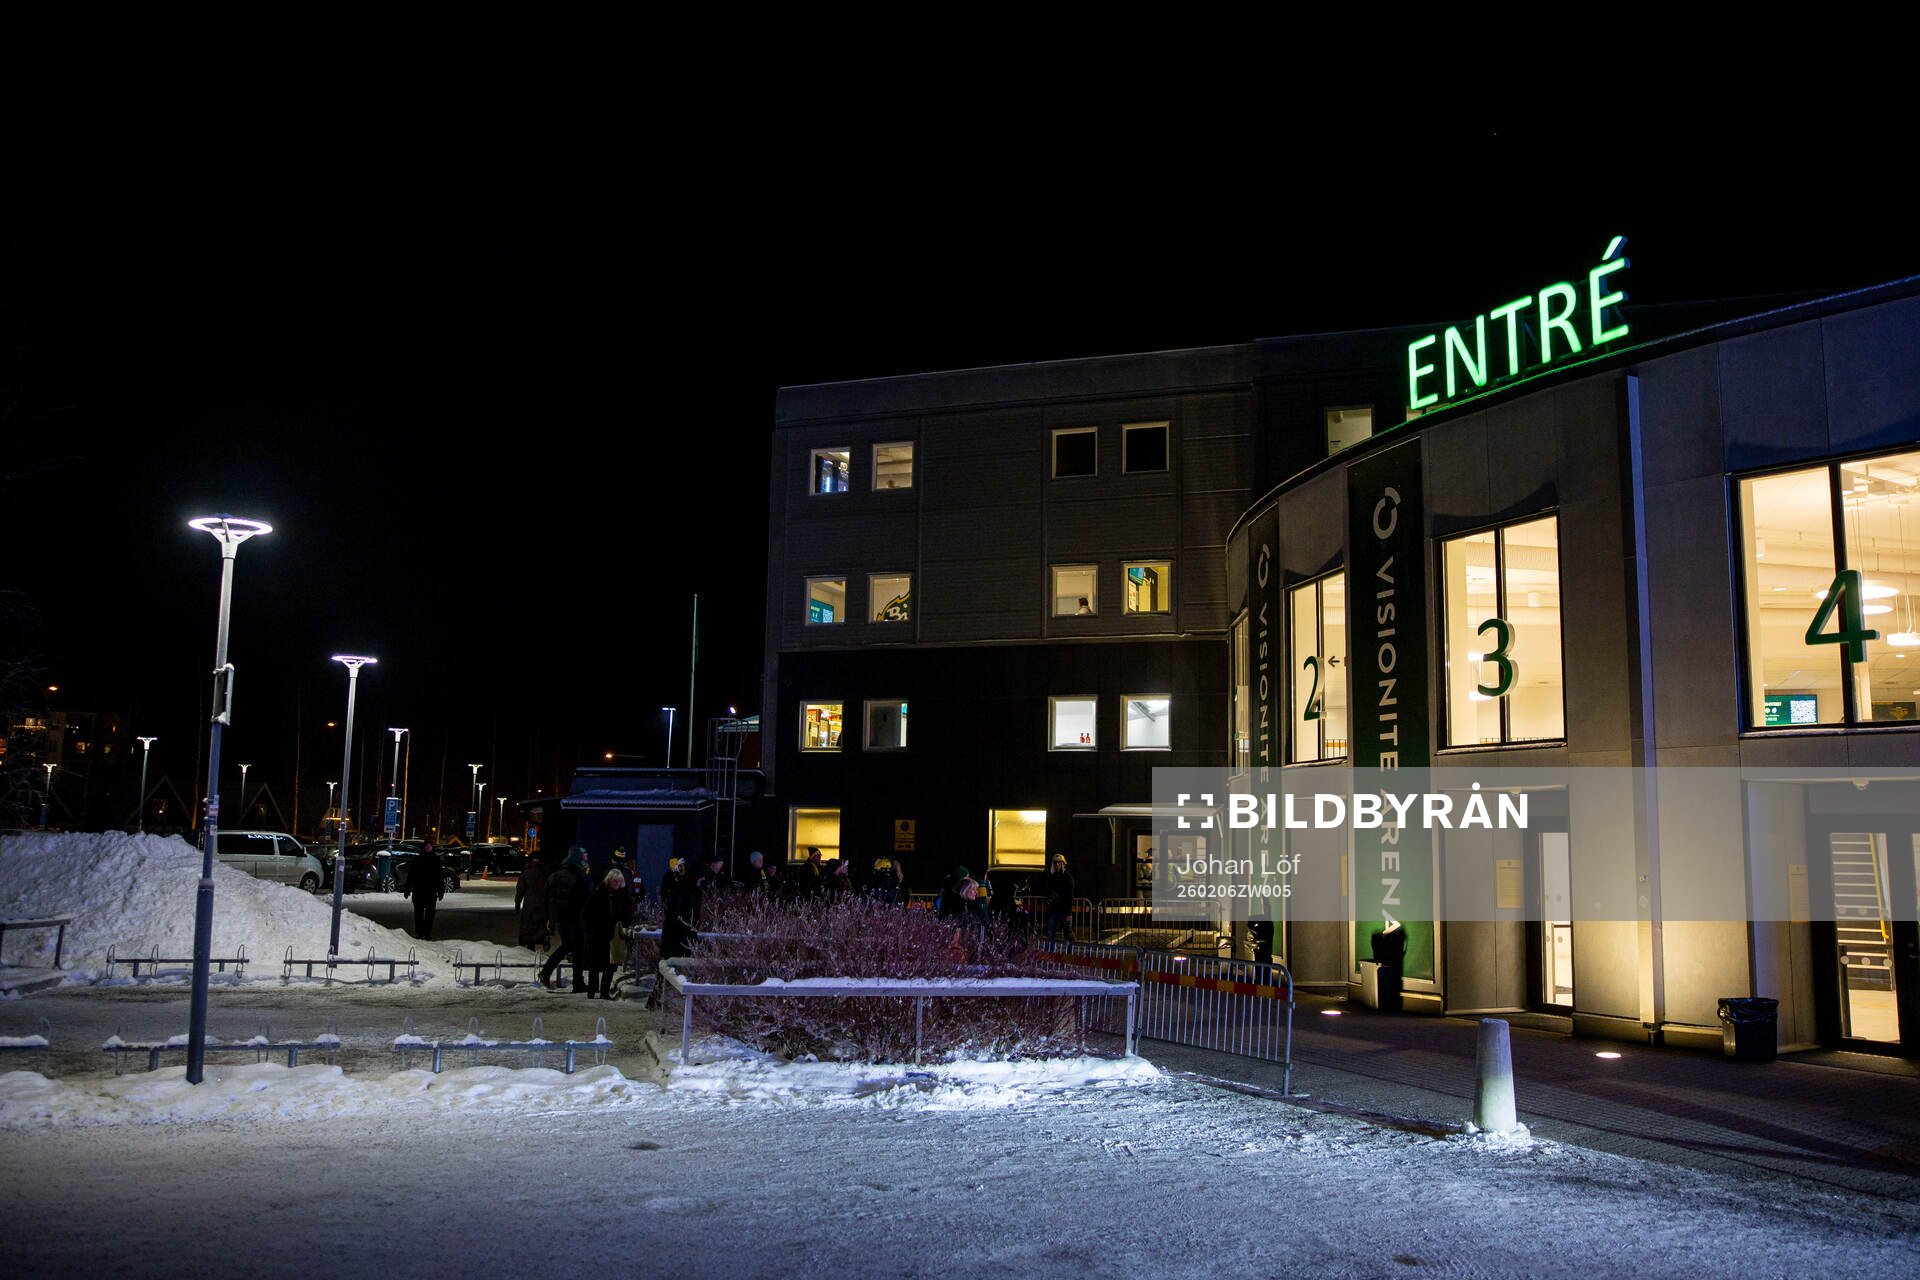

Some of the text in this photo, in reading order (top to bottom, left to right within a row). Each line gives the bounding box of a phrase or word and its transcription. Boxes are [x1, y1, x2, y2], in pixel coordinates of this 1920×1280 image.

[1407, 234, 1630, 411] ENTRÉ
[1478, 618, 1519, 697] 3
[1805, 569, 1880, 663] 4
[1259, 601, 1269, 783] VISIONITE
[1303, 655, 1327, 721] 2
[1375, 555, 1401, 935] VISIONITE ARENA
